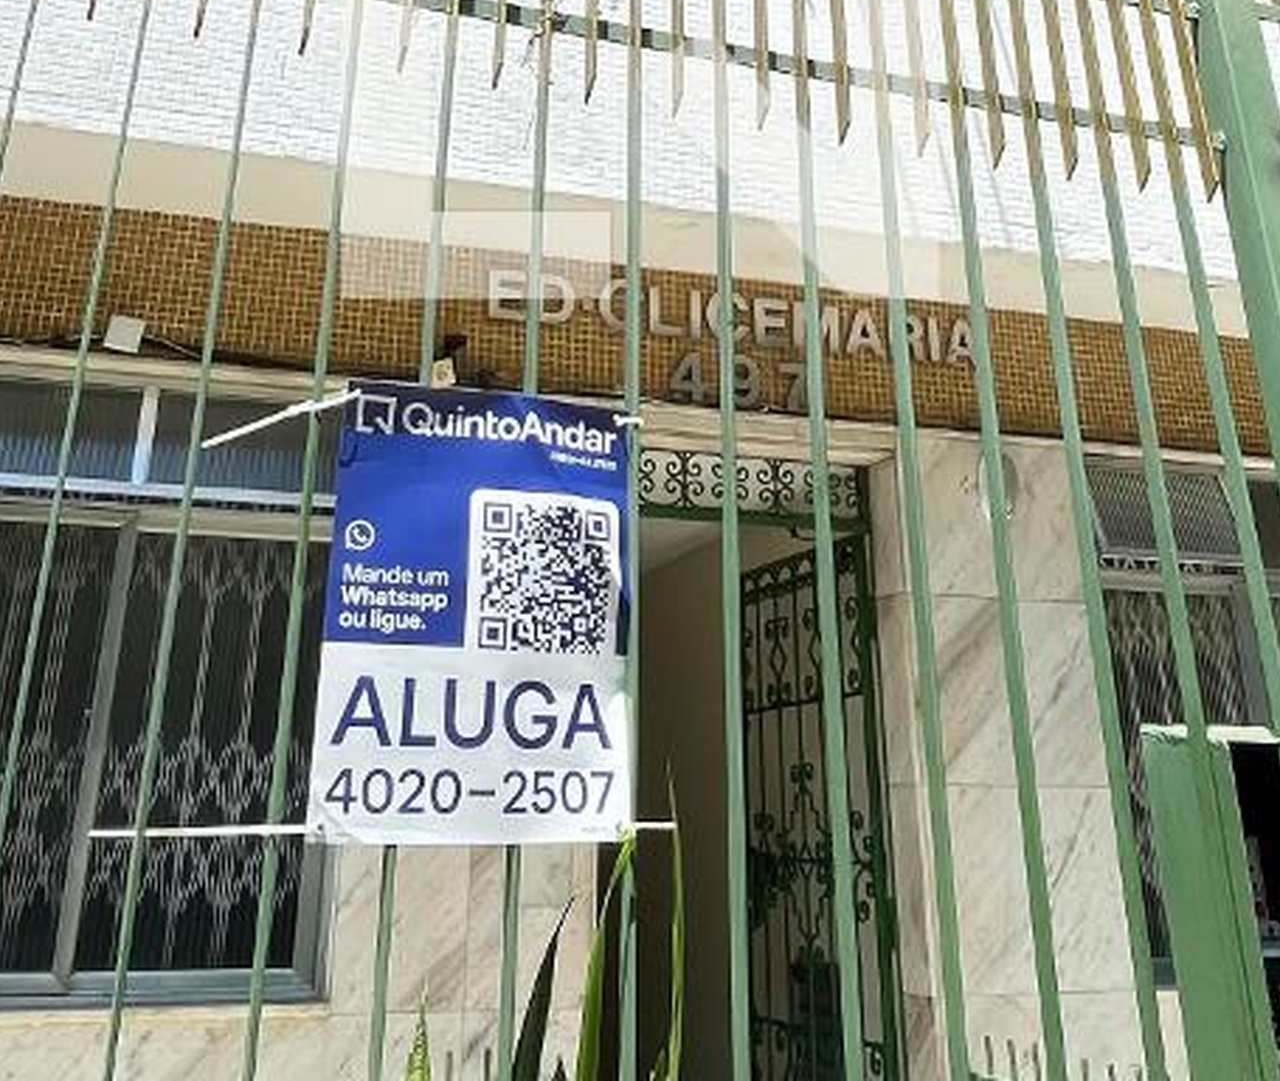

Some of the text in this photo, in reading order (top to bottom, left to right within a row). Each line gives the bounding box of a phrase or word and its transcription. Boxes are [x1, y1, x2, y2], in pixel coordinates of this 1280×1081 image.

[671, 351, 812, 412] 497
[402, 402, 618, 454] QuintoAndar
[342, 562, 449, 587] Mande um
[338, 607, 427, 635] ou ligue.
[341, 585, 449, 612] Whatsapp
[330, 675, 613, 749] ALUGA
[324, 768, 615, 815] 4020-2507
